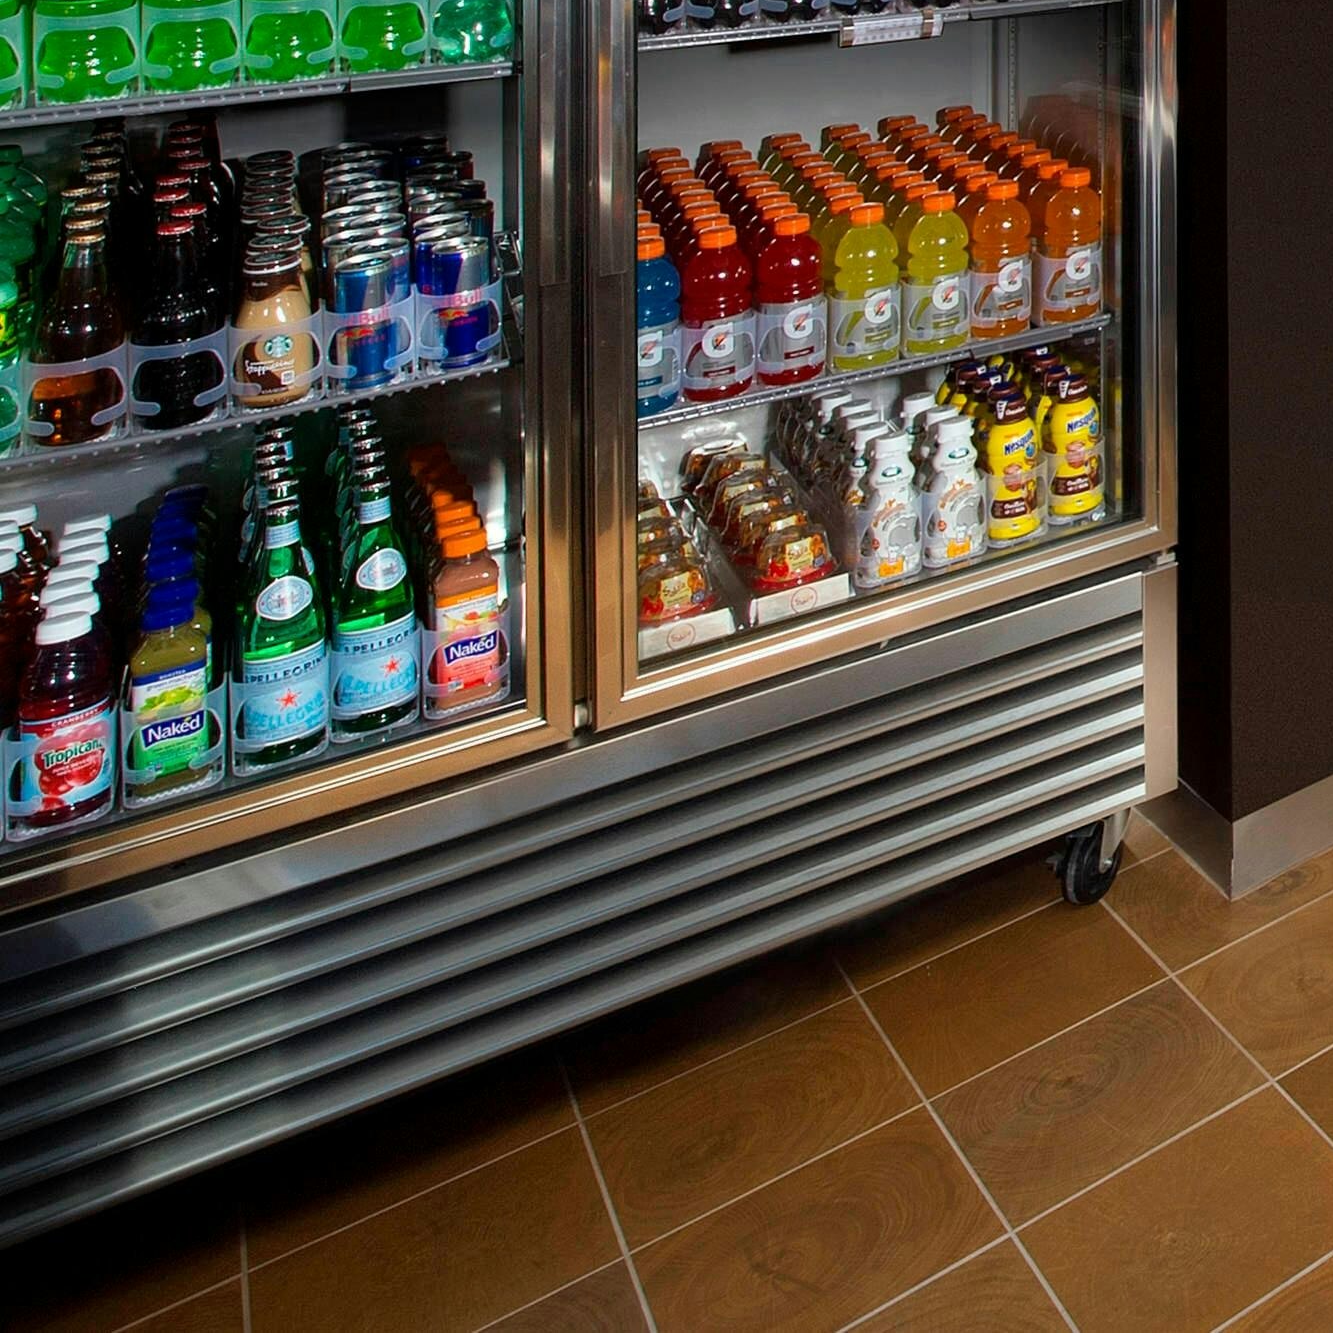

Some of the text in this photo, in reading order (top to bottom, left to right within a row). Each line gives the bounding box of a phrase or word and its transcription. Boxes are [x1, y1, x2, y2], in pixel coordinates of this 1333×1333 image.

[998, 260, 1023, 293] G
[1065, 249, 1092, 280] G
[864, 289, 892, 324] G
[932, 277, 959, 311] G
[783, 303, 814, 339] G
[702, 322, 734, 359] G
[448, 634, 495, 661] Naked
[51, 707, 101, 728] CRANBERRY
[147, 713, 201, 744] Naked
